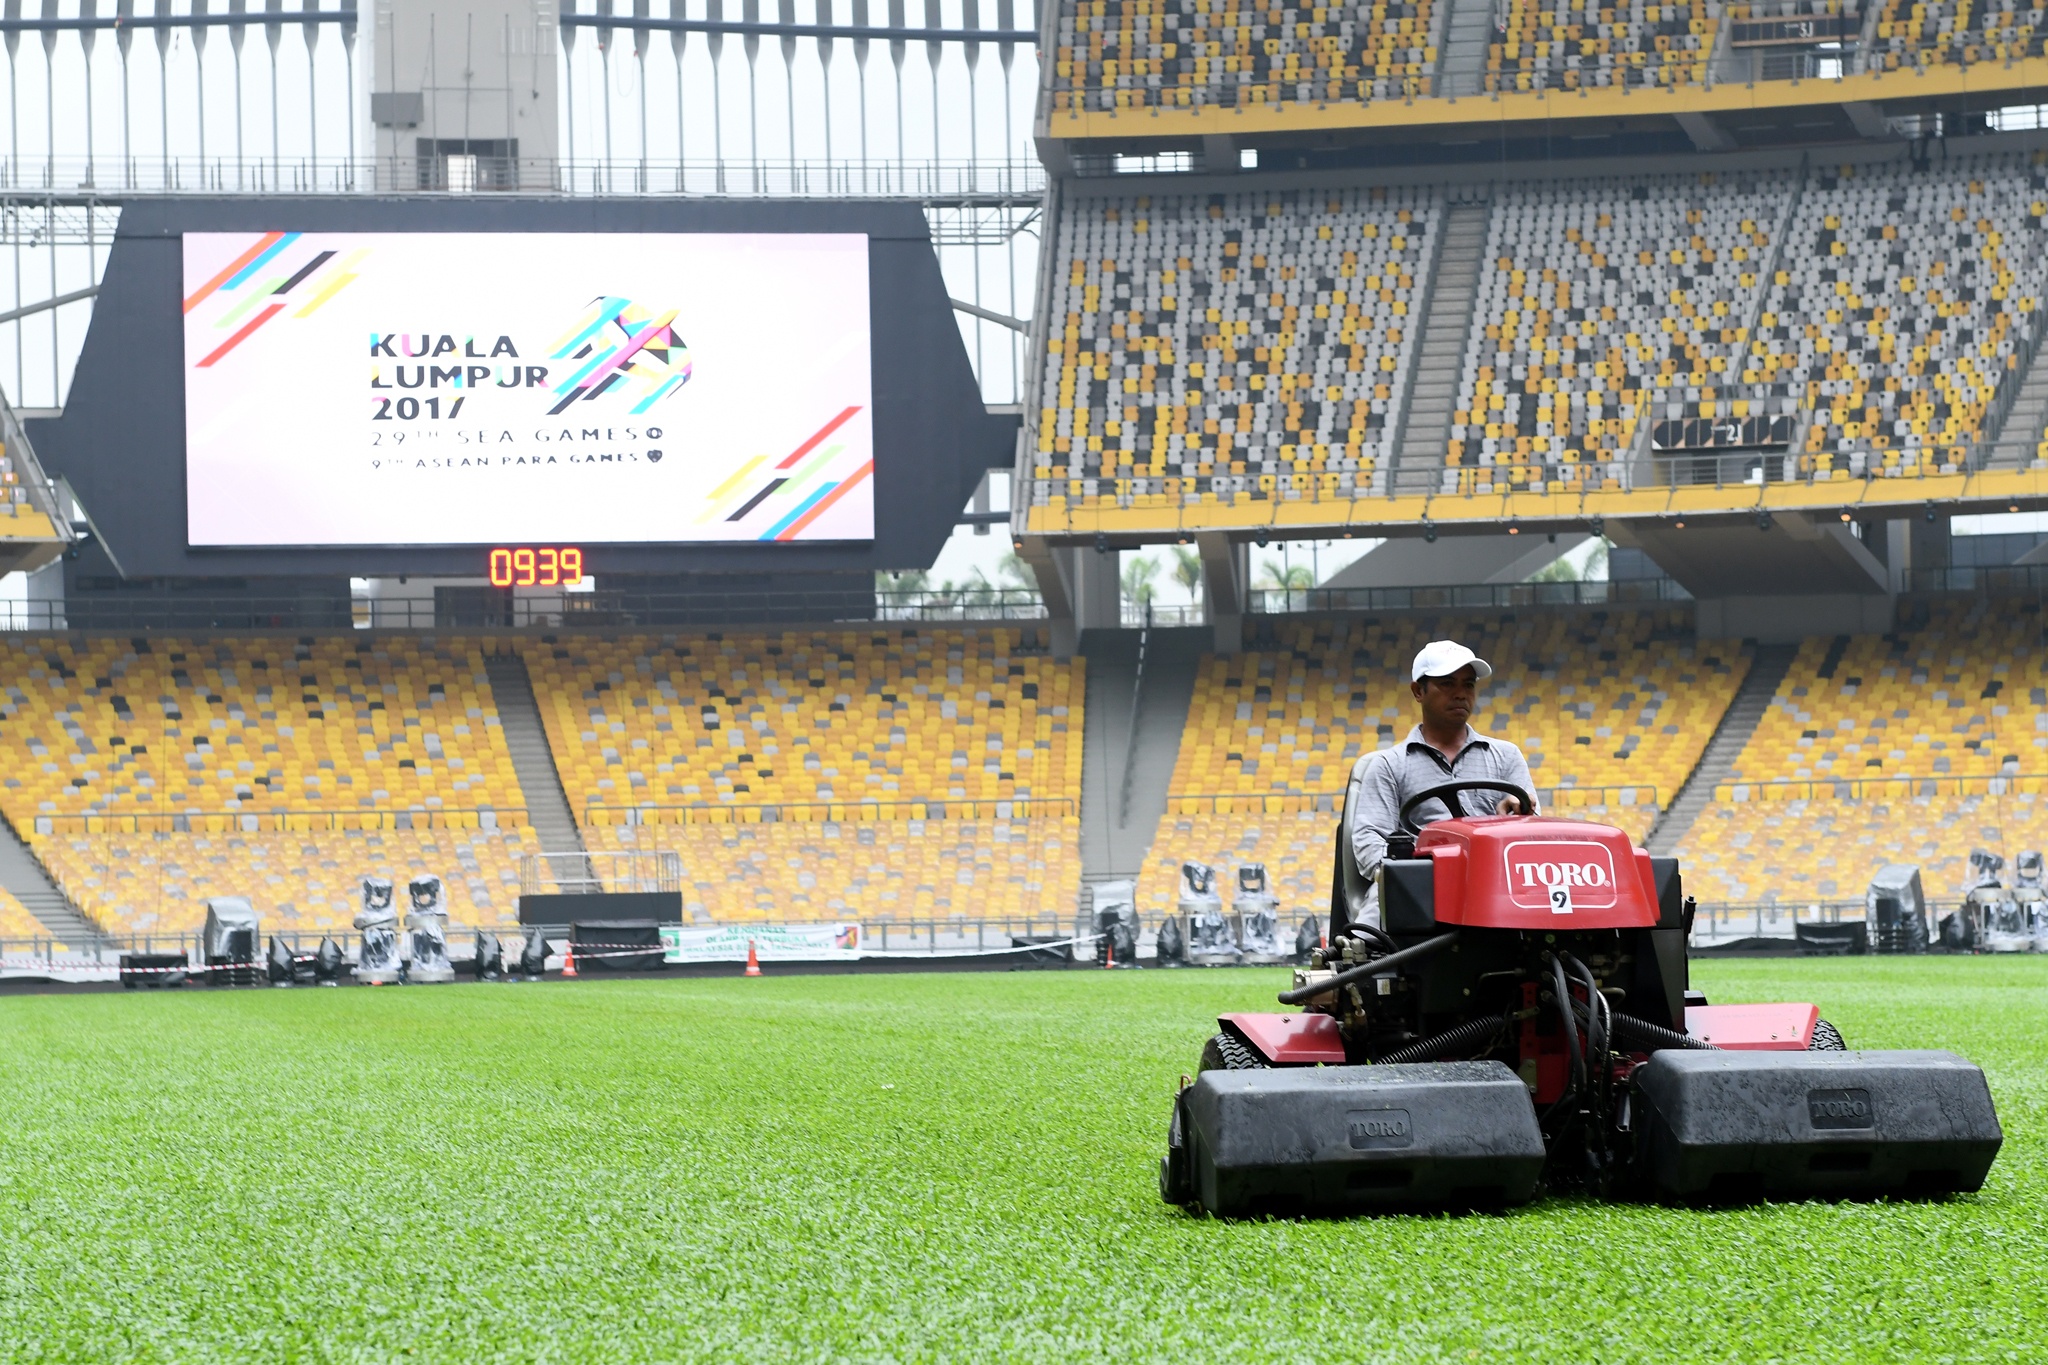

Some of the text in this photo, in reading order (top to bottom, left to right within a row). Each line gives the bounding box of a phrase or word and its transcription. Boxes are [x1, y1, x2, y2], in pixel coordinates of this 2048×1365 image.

[370, 333, 519, 358] KUALA
[371, 364, 549, 389] LUMPUR
[372, 396, 465, 420] 2017
[458, 430, 514, 444] SEA
[535, 427, 637, 442] GAMES
[416, 457, 489, 468] ASEAN
[502, 456, 558, 466] PARA
[570, 453, 638, 464] GAMES
[490, 548, 583, 587] 0939
[1515, 862, 1606, 887] TORO
[1552, 891, 1567, 908] 9
[1811, 1101, 1867, 1118] TORO
[1348, 1121, 1407, 1138] TORO
